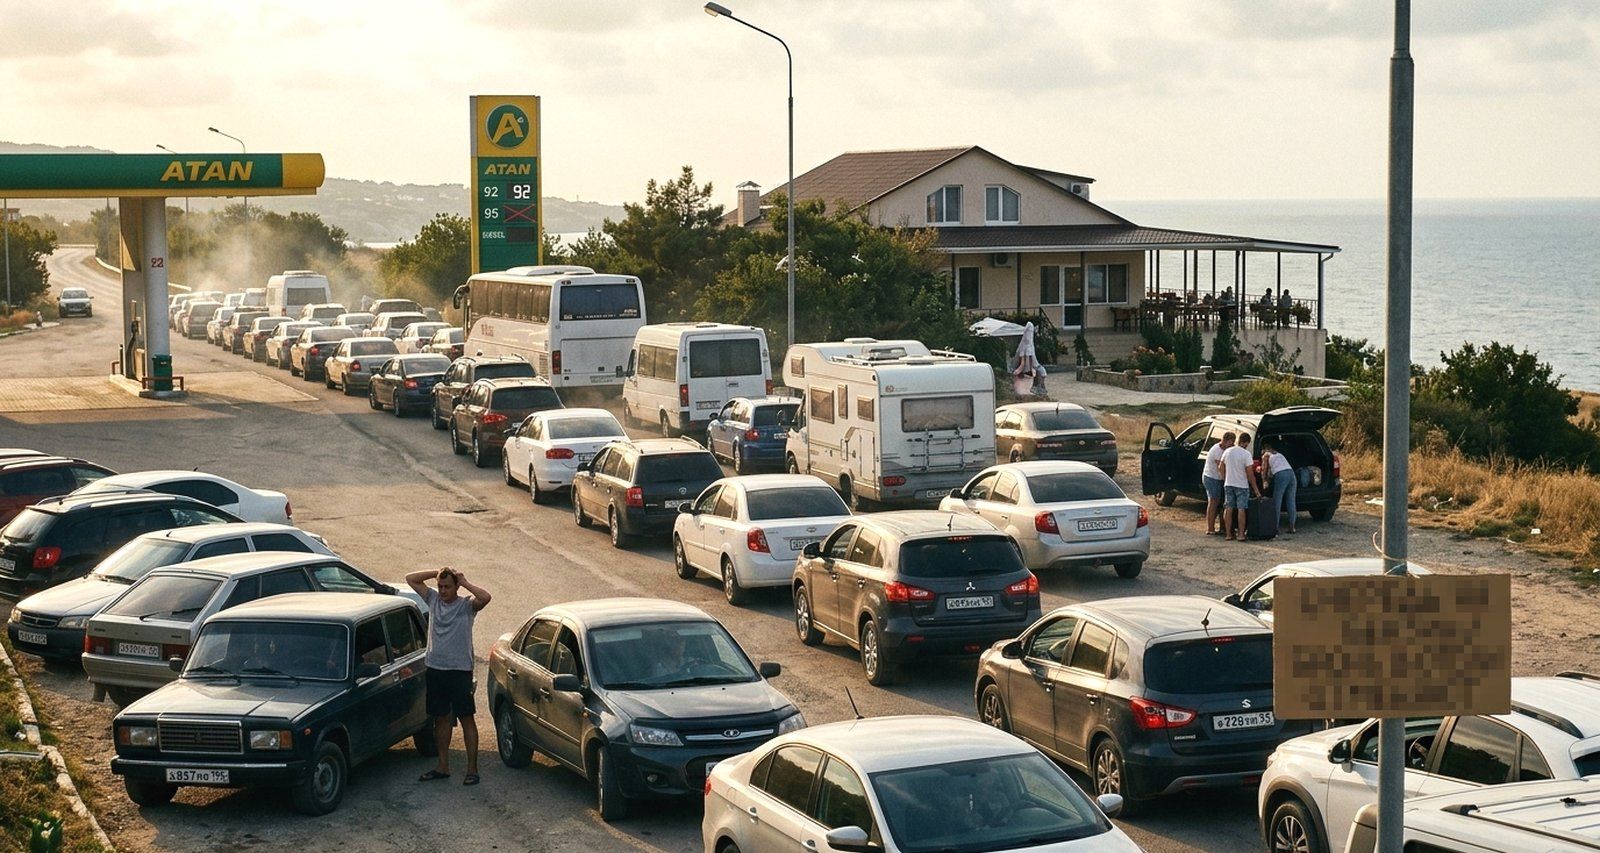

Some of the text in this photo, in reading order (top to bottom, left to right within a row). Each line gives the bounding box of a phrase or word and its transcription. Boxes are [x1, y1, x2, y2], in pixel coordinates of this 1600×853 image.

[160, 161, 253, 181] ATAN
[484, 163, 531, 175] ATAN
[484, 184, 531, 199] 92 92
[484, 208, 498, 219] 95
